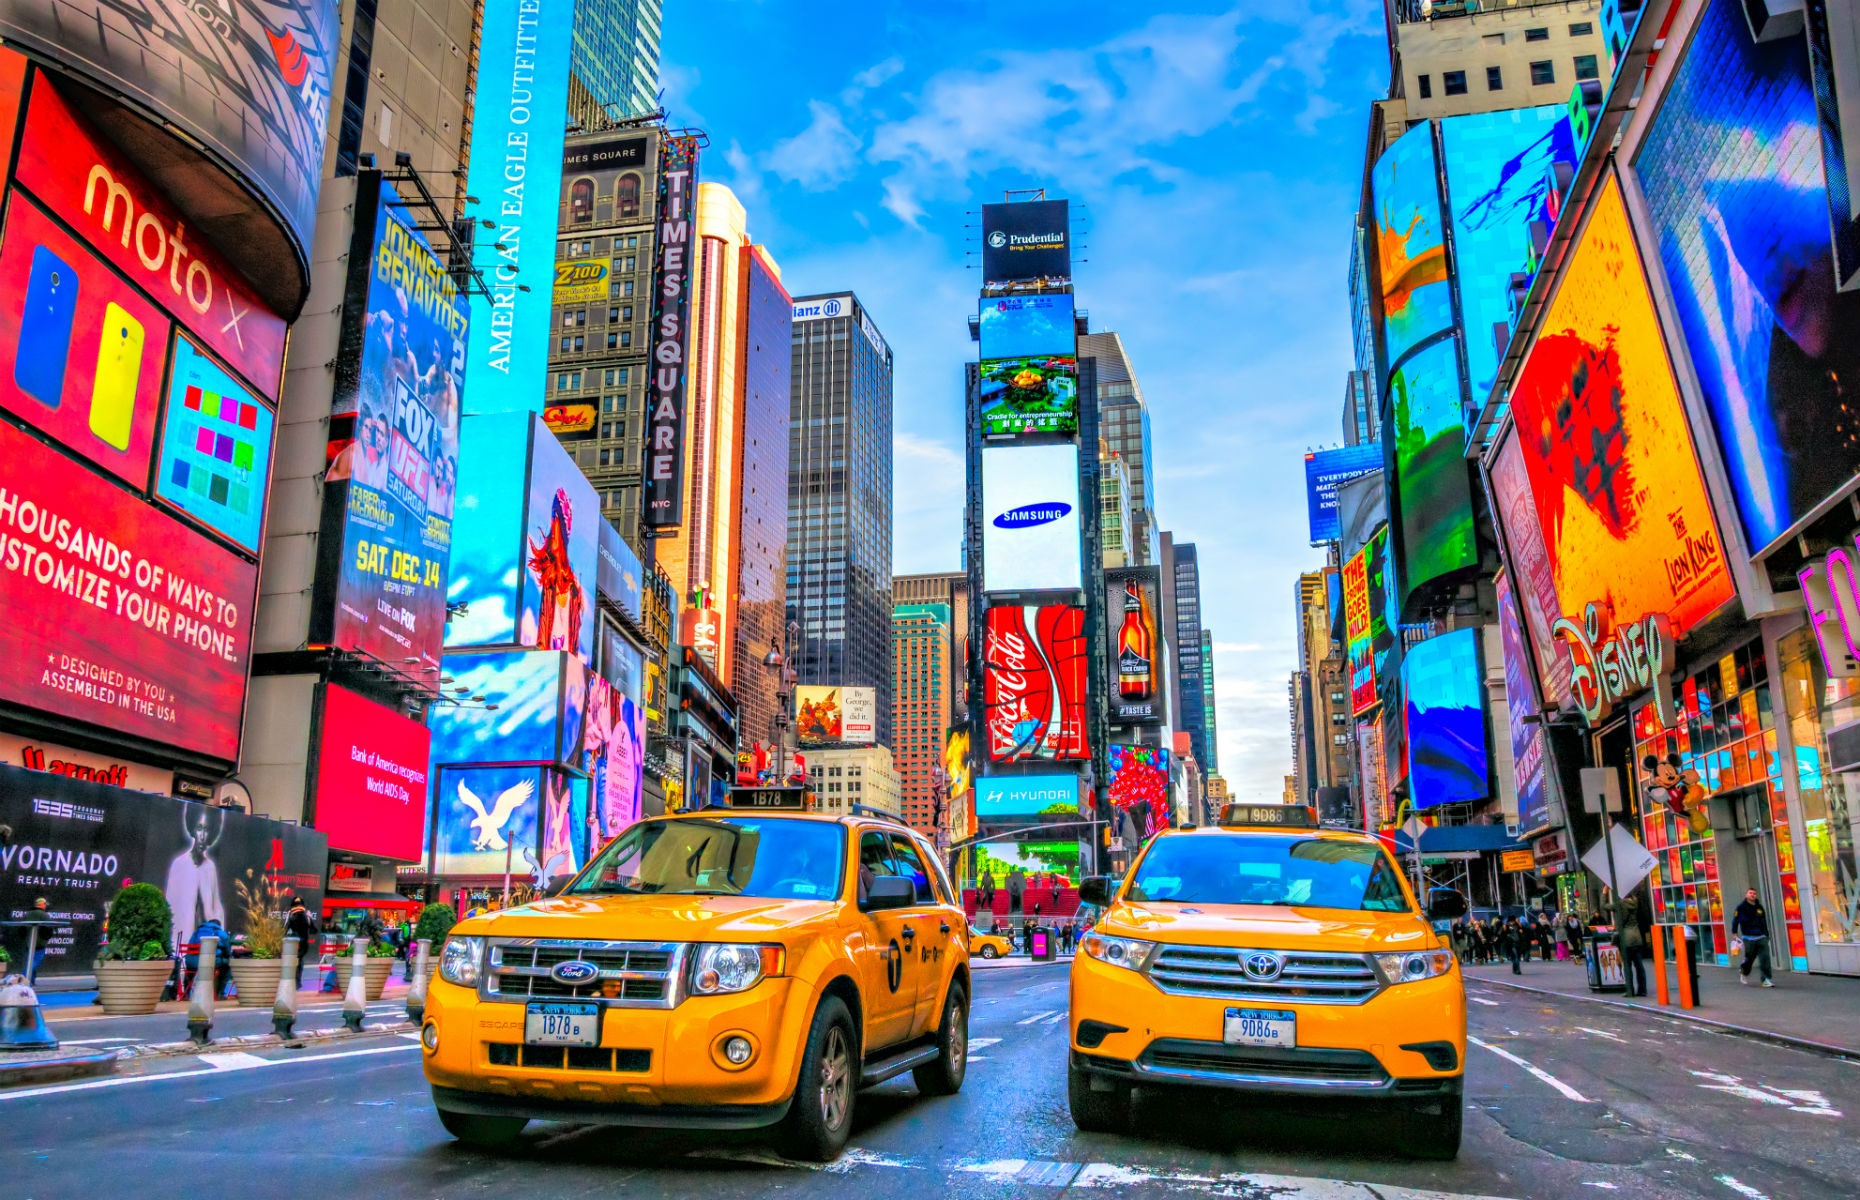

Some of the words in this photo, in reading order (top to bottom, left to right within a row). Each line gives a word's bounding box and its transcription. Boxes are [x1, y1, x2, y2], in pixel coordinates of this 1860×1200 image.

[178, 0, 232, 38] ion
[510, 0, 540, 125] OUTFITTE
[592, 149, 637, 161] SQUARE
[501, 131, 528, 216] EAGLE
[83, 164, 213, 314] moto
[661, 171, 688, 297] TIMES
[1010, 232, 1064, 244] Prudential
[554, 264, 602, 286] Z100
[378, 244, 468, 346] BENAVIDEZ
[488, 224, 520, 374] AMERICAN
[793, 305, 821, 318] ianz
[651, 313, 682, 480] SQUARE
[394, 388, 435, 460] FOX
[1019, 411, 1073, 420] entrepreneurship
[390, 435, 428, 496] UFC
[353, 485, 379, 505] FABER
[387, 473, 428, 519] SATURDAY
[651, 500, 671, 509] NYC
[352, 498, 395, 528] McDONALD
[1003, 509, 1062, 522] SAMSUNG
[0, 488, 132, 579] HOUSANDS
[135, 558, 164, 593] OF
[168, 572, 214, 618] WAYS
[217, 597, 238, 629] TO
[357, 540, 389, 577] SAT.
[392, 550, 422, 585] DEC.
[423, 559, 440, 589] 14
[1344, 553, 1364, 589] THE
[1664, 552, 1691, 597] LION
[1685, 530, 1715, 579] KING
[1346, 578, 1366, 604] CROWD
[1799, 533, 1860, 679] FO
[377, 598, 392, 617] LIVE
[391, 608, 401, 623] ON
[400, 607, 416, 633] FOX
[1347, 592, 1366, 622] GOES
[115, 584, 171, 635] YOUR
[173, 612, 238, 663] PHONE.
[61, 653, 124, 689] DESIGNED
[127, 672, 142, 693] BY
[144, 676, 166, 703] YOU
[986, 625, 1028, 748] Coca-Cola
[41, 670, 115, 705] ASSEMBLED
[118, 692, 130, 710] IN
[133, 694, 155, 717] THE
[156, 701, 176, 724] USA
[845, 698, 872, 706] George,
[1120, 705, 1144, 715] #TASTE
[1145, 705, 1151, 714] IS
[850, 712, 860, 720] did
[351, 745, 366, 764] Bank
[367, 752, 376, 766] of
[375, 754, 398, 774] America
[367, 776, 384, 795] World
[384, 782, 398, 799] AIDS
[398, 786, 410, 805] Day
[751, 791, 781, 806] 1B78
[1010, 790, 1070, 800] HYUNDAI
[1253, 808, 1283, 823] 9D86
[1, 845, 118, 877] VORNADO
[18, 875, 60, 887] REALTY
[64, 878, 100, 889] TRUST
[57, 927, 73, 935] WHITE
[561, 966, 585, 978] Ford
[543, 1015, 571, 1035] 1B78
[573, 1026, 580, 1035] B
[1241, 1019, 1271, 1038] 9D86
[1271, 1029, 1279, 1038] B
